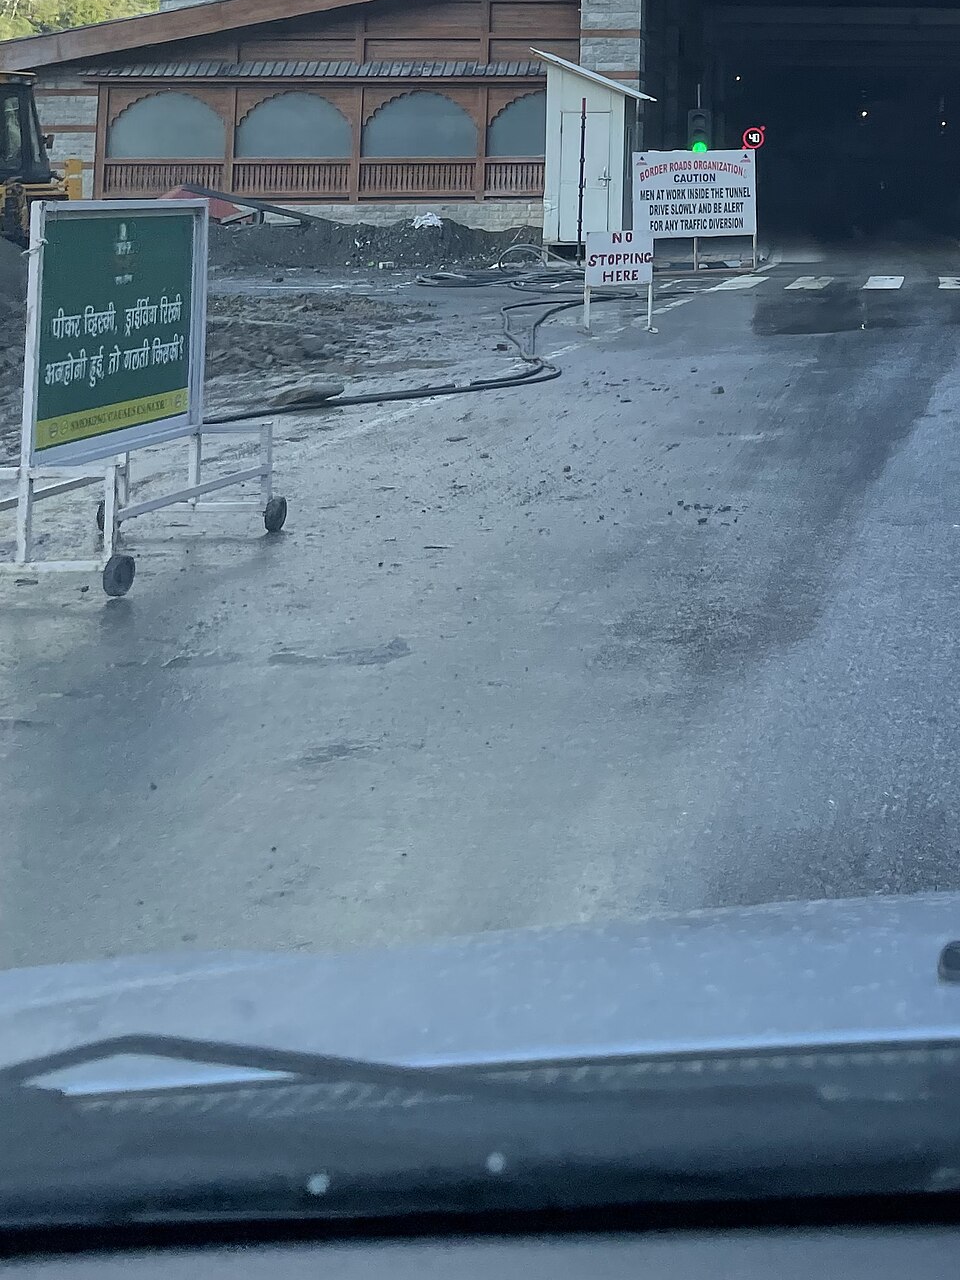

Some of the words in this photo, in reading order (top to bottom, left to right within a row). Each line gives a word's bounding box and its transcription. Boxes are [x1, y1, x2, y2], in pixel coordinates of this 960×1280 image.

[748, 133, 760, 143] 40
[639, 164, 668, 182] BORDER
[669, 160, 692, 172] ROADS
[673, 173, 716, 183] CAUTION
[640, 189, 655, 201] MEN
[656, 189, 665, 201] AT
[665, 188, 686, 200] WORK
[687, 188, 709, 199] INSIDE
[711, 187, 724, 199] THE
[725, 186, 751, 198] TUNNEL
[649, 204, 669, 216] DRIVE
[670, 203, 697, 215] SLOWLY
[698, 203, 712, 214] AND
[713, 202, 722, 213] BE
[723, 201, 744, 213] ALERT
[650, 220, 663, 232] FOR
[664, 220, 679, 231] ANY
[680, 219, 707, 231] TRAFFIC
[708, 217, 744, 230] DIVERSION
[612, 232, 633, 244] NO
[588, 252, 653, 267] STOPPING
[602, 269, 639, 282] HERE
[52, 308, 82, 340] पीकर
[107, 344, 122, 375] तो
[123, 338, 150, 371] गलती
